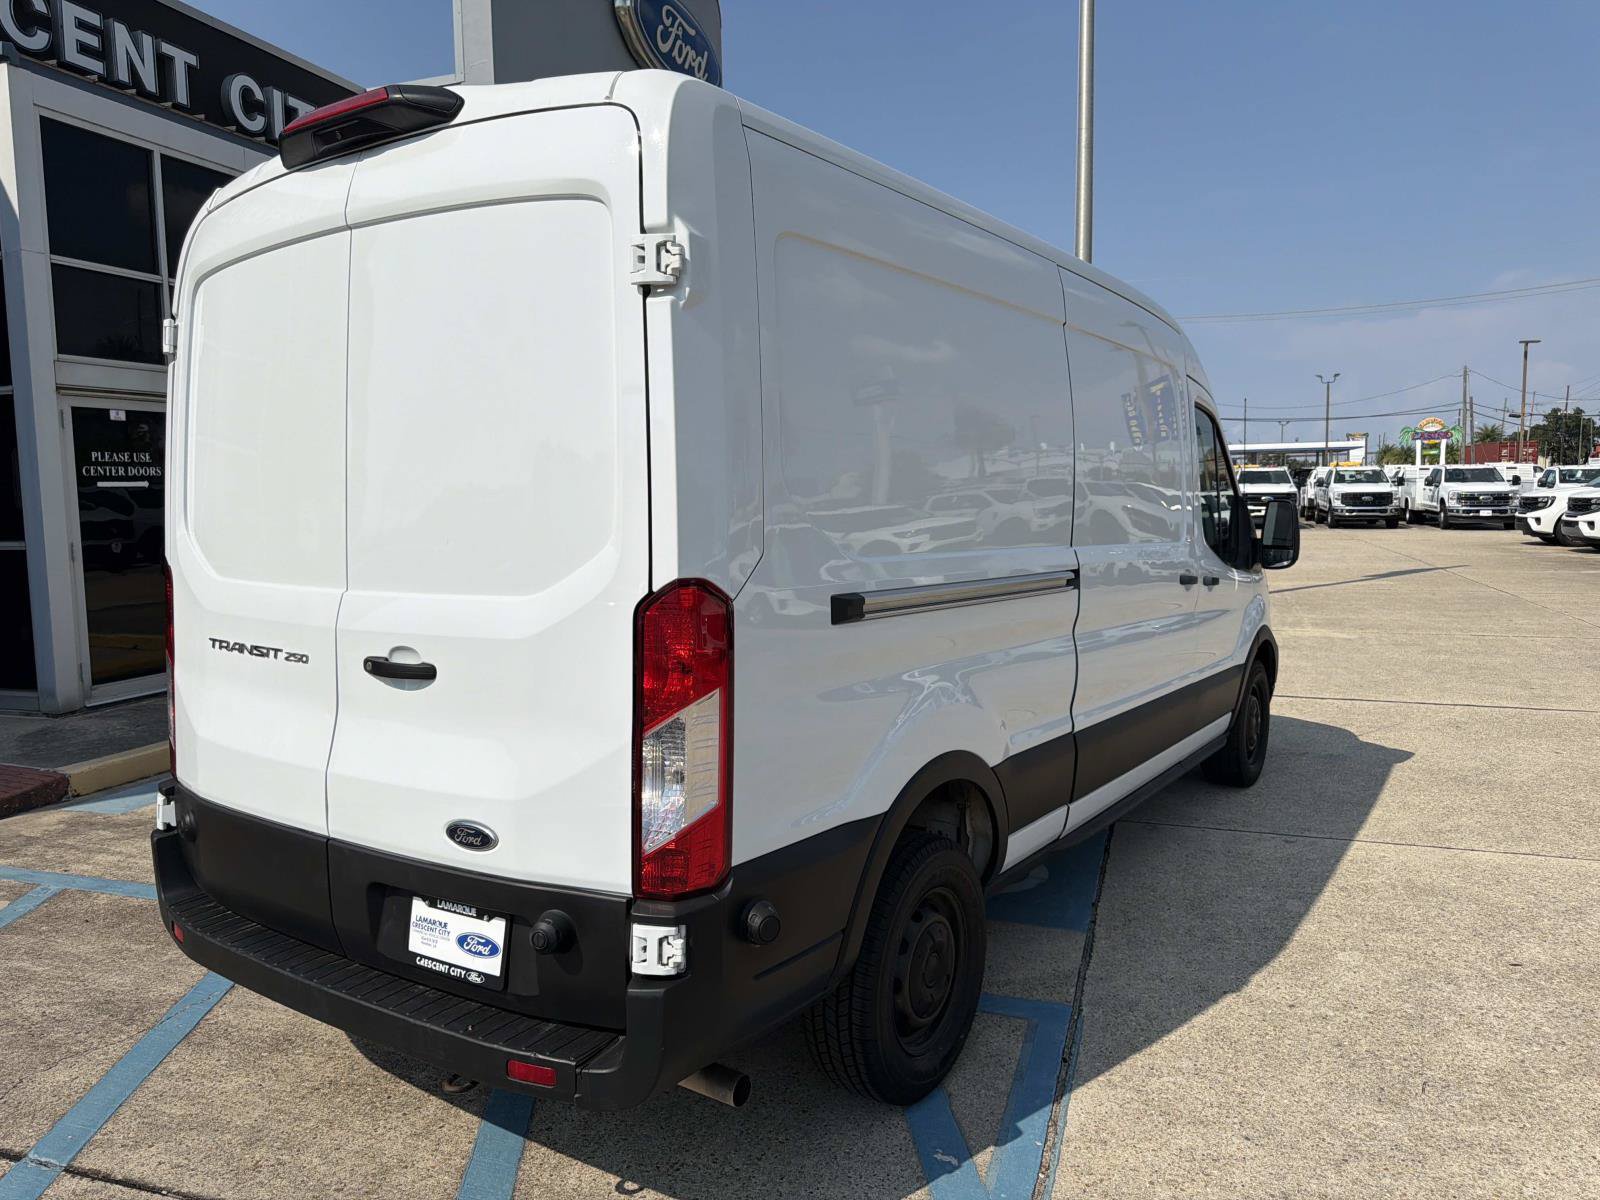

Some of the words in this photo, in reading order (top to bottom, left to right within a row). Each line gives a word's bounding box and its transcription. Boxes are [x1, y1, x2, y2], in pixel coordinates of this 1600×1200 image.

[656, 4, 709, 80] Ford
[91, 451, 131, 462] PLEASE
[133, 452, 152, 463] USE
[82, 465, 126, 477] CENTER
[128, 466, 162, 477] DOORS
[208, 637, 284, 660] TRANSIT
[284, 651, 310, 665] 250
[454, 827, 483, 847] Ford
[437, 899, 477, 916] LAMARQUE
[411, 920, 438, 933] CRESCENT
[438, 928, 451, 937] CITY
[415, 914, 449, 930] LAMARQUE
[463, 935, 492, 955] Ford
[416, 956, 449, 974] CRESCENT
[449, 966, 467, 979] CITY
